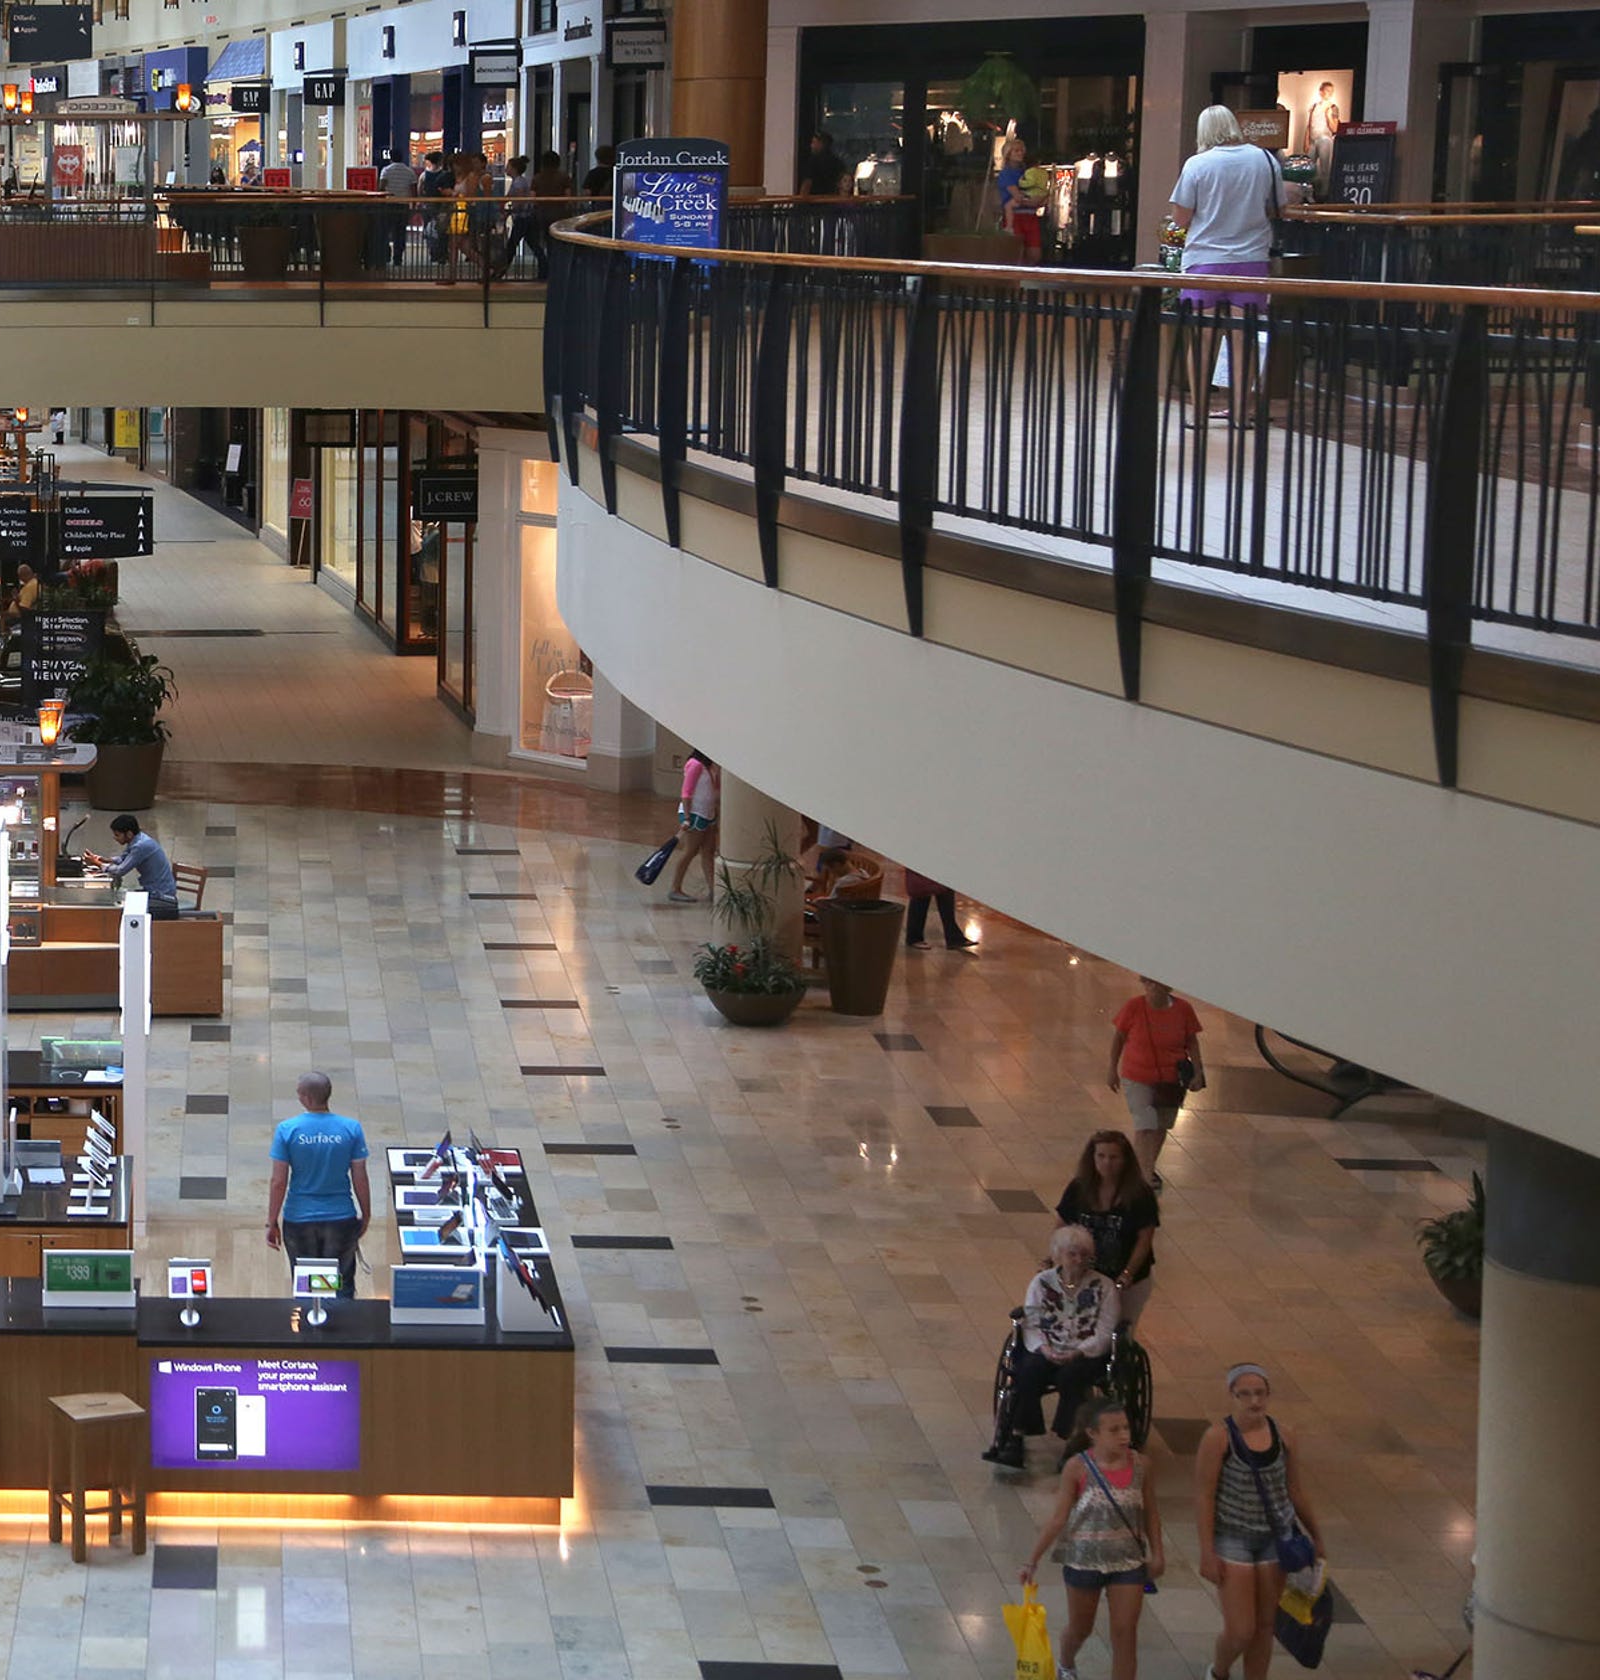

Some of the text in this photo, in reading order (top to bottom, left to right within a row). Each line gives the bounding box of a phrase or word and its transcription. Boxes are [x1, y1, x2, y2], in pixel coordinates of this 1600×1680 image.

[314, 82, 335, 99] GAP
[243, 91, 259, 102] GAP
[615, 150, 728, 170] Jordan Creek
[1342, 163, 1380, 172] ALL JEANS
[639, 172, 697, 197] Live
[1344, 175, 1375, 184] ON SALE
[656, 193, 718, 212] Creek
[426, 492, 474, 506] J.CREW
[64, 507, 90, 515] Dillard's
[9, 519, 27, 527] Place
[8, 530, 28, 538] Apple
[64, 531, 126, 540] Children's Play Place
[72, 545, 92, 553] Apple
[31, 660, 58, 670] NEW
[33, 672, 61, 681] NEW
[298, 1132, 343, 1145] Surface
[174, 1362, 242, 1374] Windows Phone
[257, 1360, 319, 1371] Meet Cortana,
[257, 1370, 318, 1383] your personal
[257, 1382, 348, 1393] smartphone assistant
